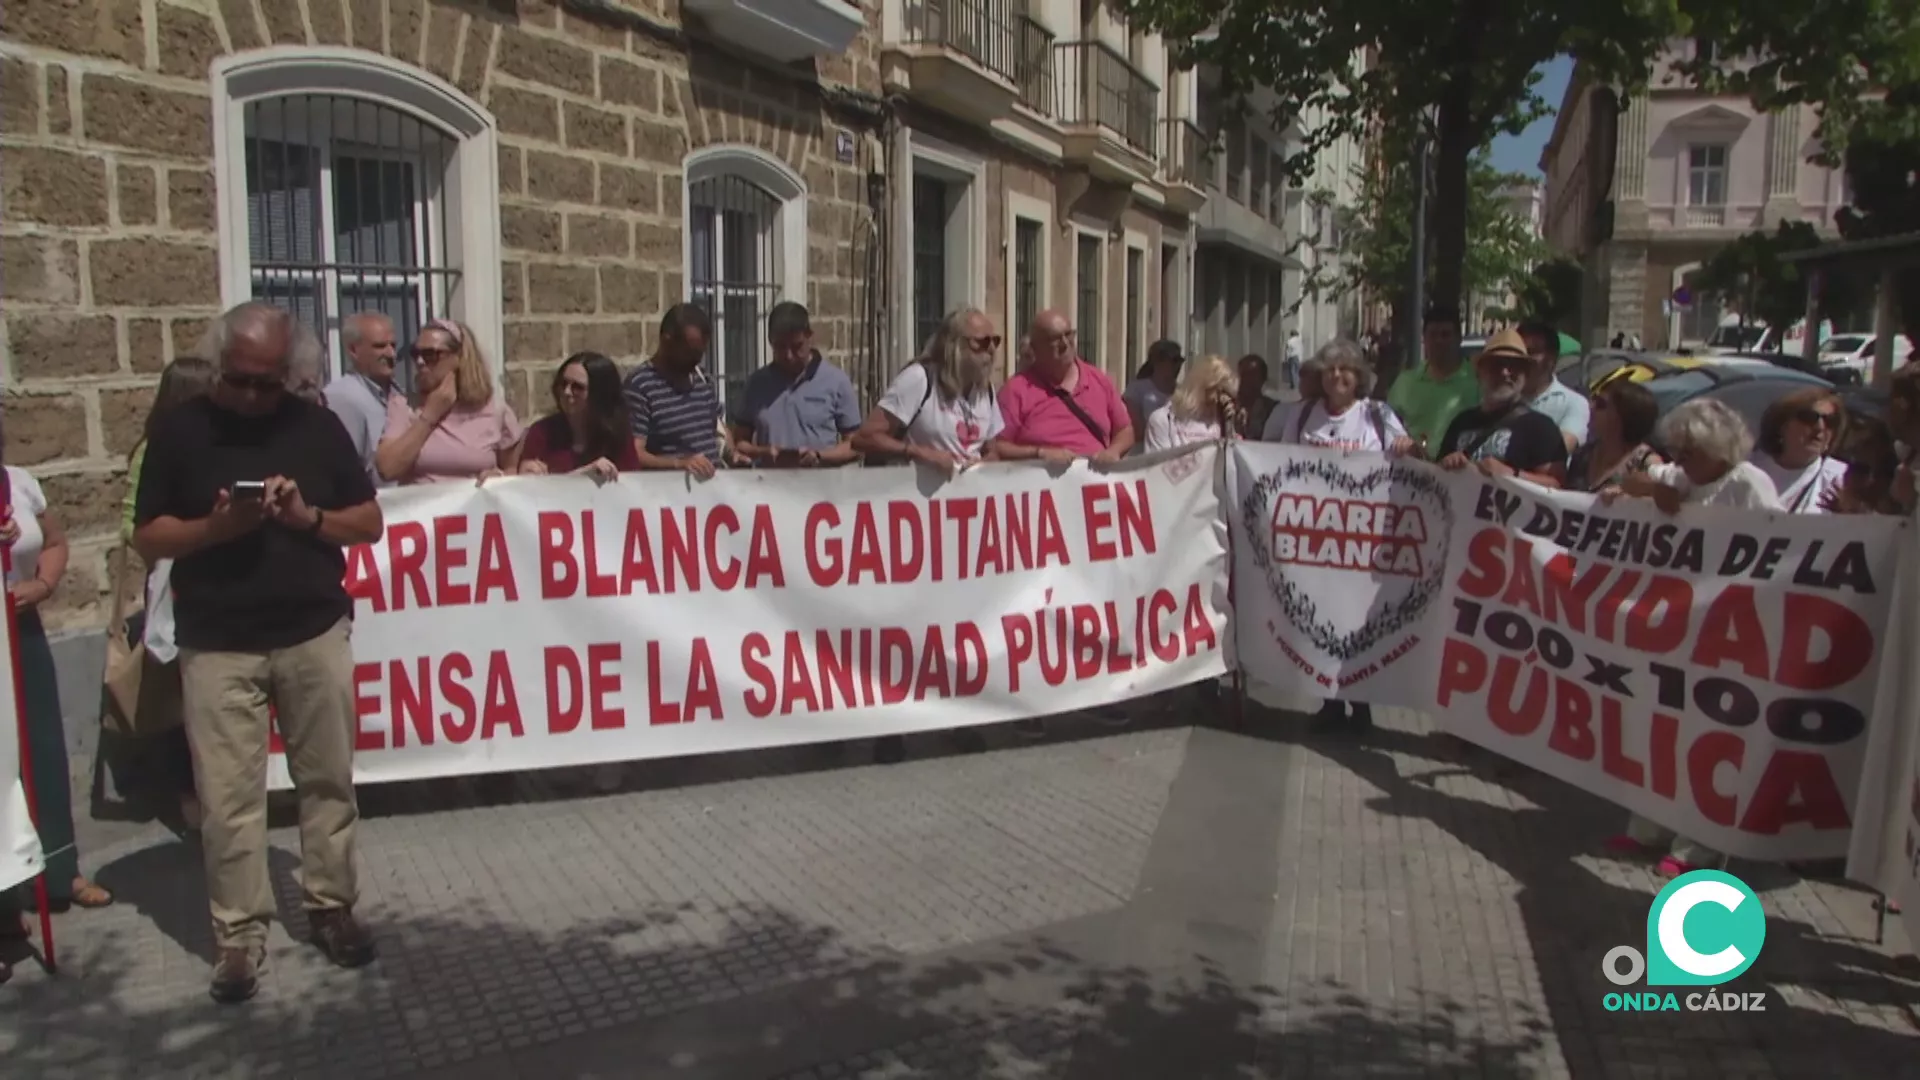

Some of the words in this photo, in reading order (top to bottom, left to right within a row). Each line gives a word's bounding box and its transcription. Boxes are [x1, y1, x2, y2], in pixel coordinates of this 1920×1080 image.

[344, 512, 518, 614] AREA
[538, 504, 785, 599] BLANCA
[804, 489, 1070, 586] GADITANA
[1081, 480, 1156, 562] EN
[1272, 493, 1427, 543] MAREA
[1273, 532, 1423, 577] BLANCA
[1522, 502, 1704, 577] DEFENSA
[1717, 534, 1791, 580] DE
[1794, 540, 1876, 594] LA
[266, 650, 524, 753] ENSA
[543, 642, 625, 734] DE
[646, 637, 724, 725] LA
[740, 621, 988, 717] SANIDAD
[1000, 587, 1216, 692] PÚBLICA
[1453, 597, 1574, 670] 100
[1649, 661, 1865, 745] 100
[1457, 526, 1875, 690] SANIDAD
[1336, 663, 1379, 688] SANTA
[1436, 638, 1852, 835] PÚBLICA
